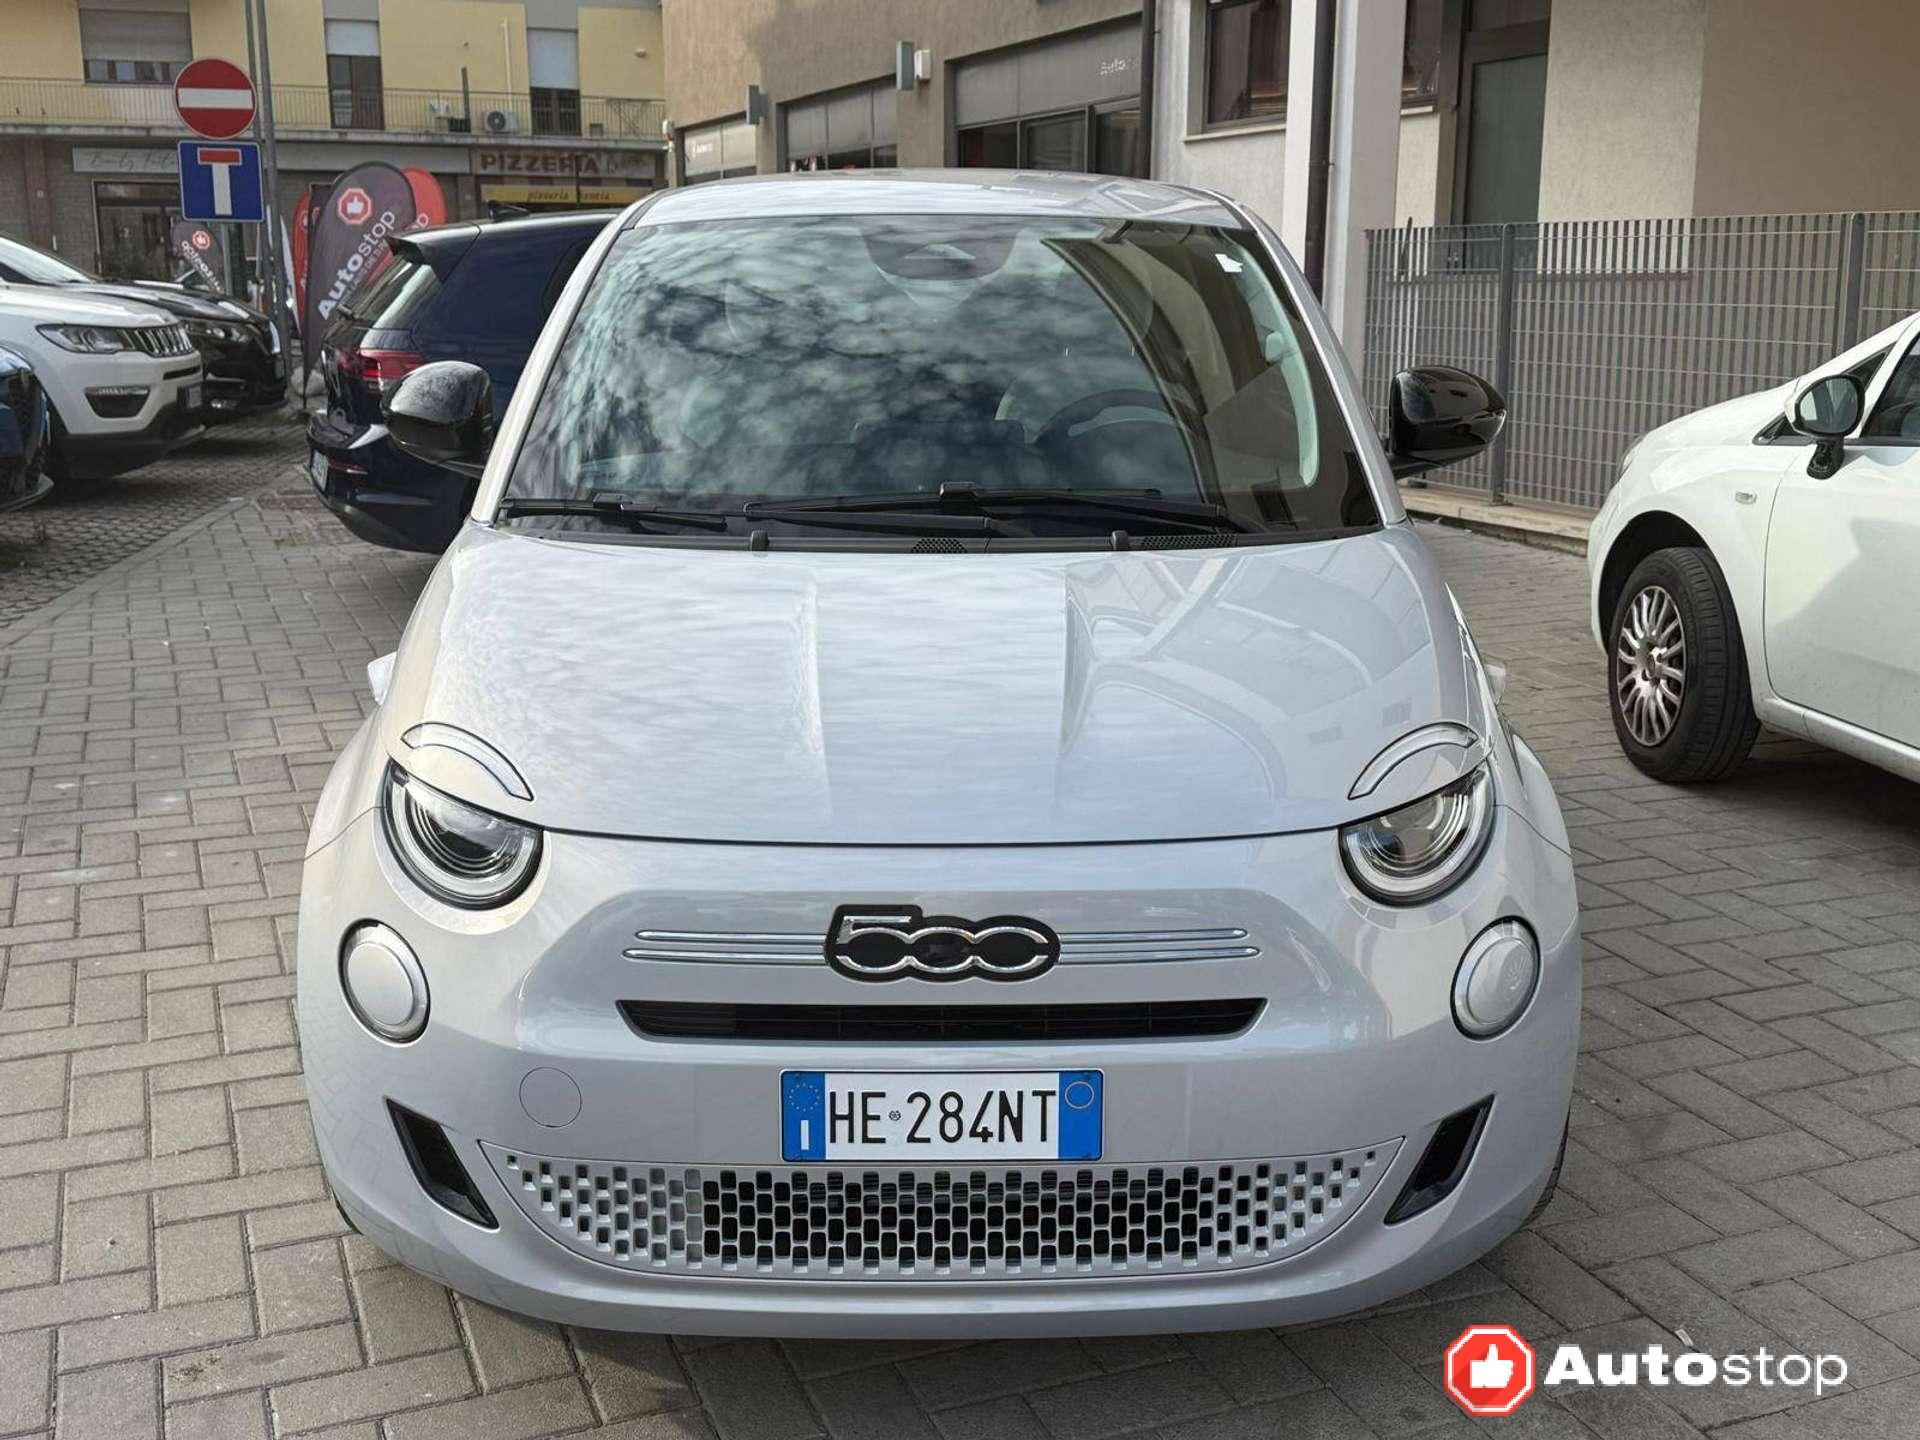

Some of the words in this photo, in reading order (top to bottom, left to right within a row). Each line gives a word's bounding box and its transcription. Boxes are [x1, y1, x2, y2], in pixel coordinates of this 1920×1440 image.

[318, 211, 396, 320] Autostop
[835, 915, 1050, 974] 500
[829, 1091, 886, 1144] HE
[905, 1090, 1057, 1144] 284NT
